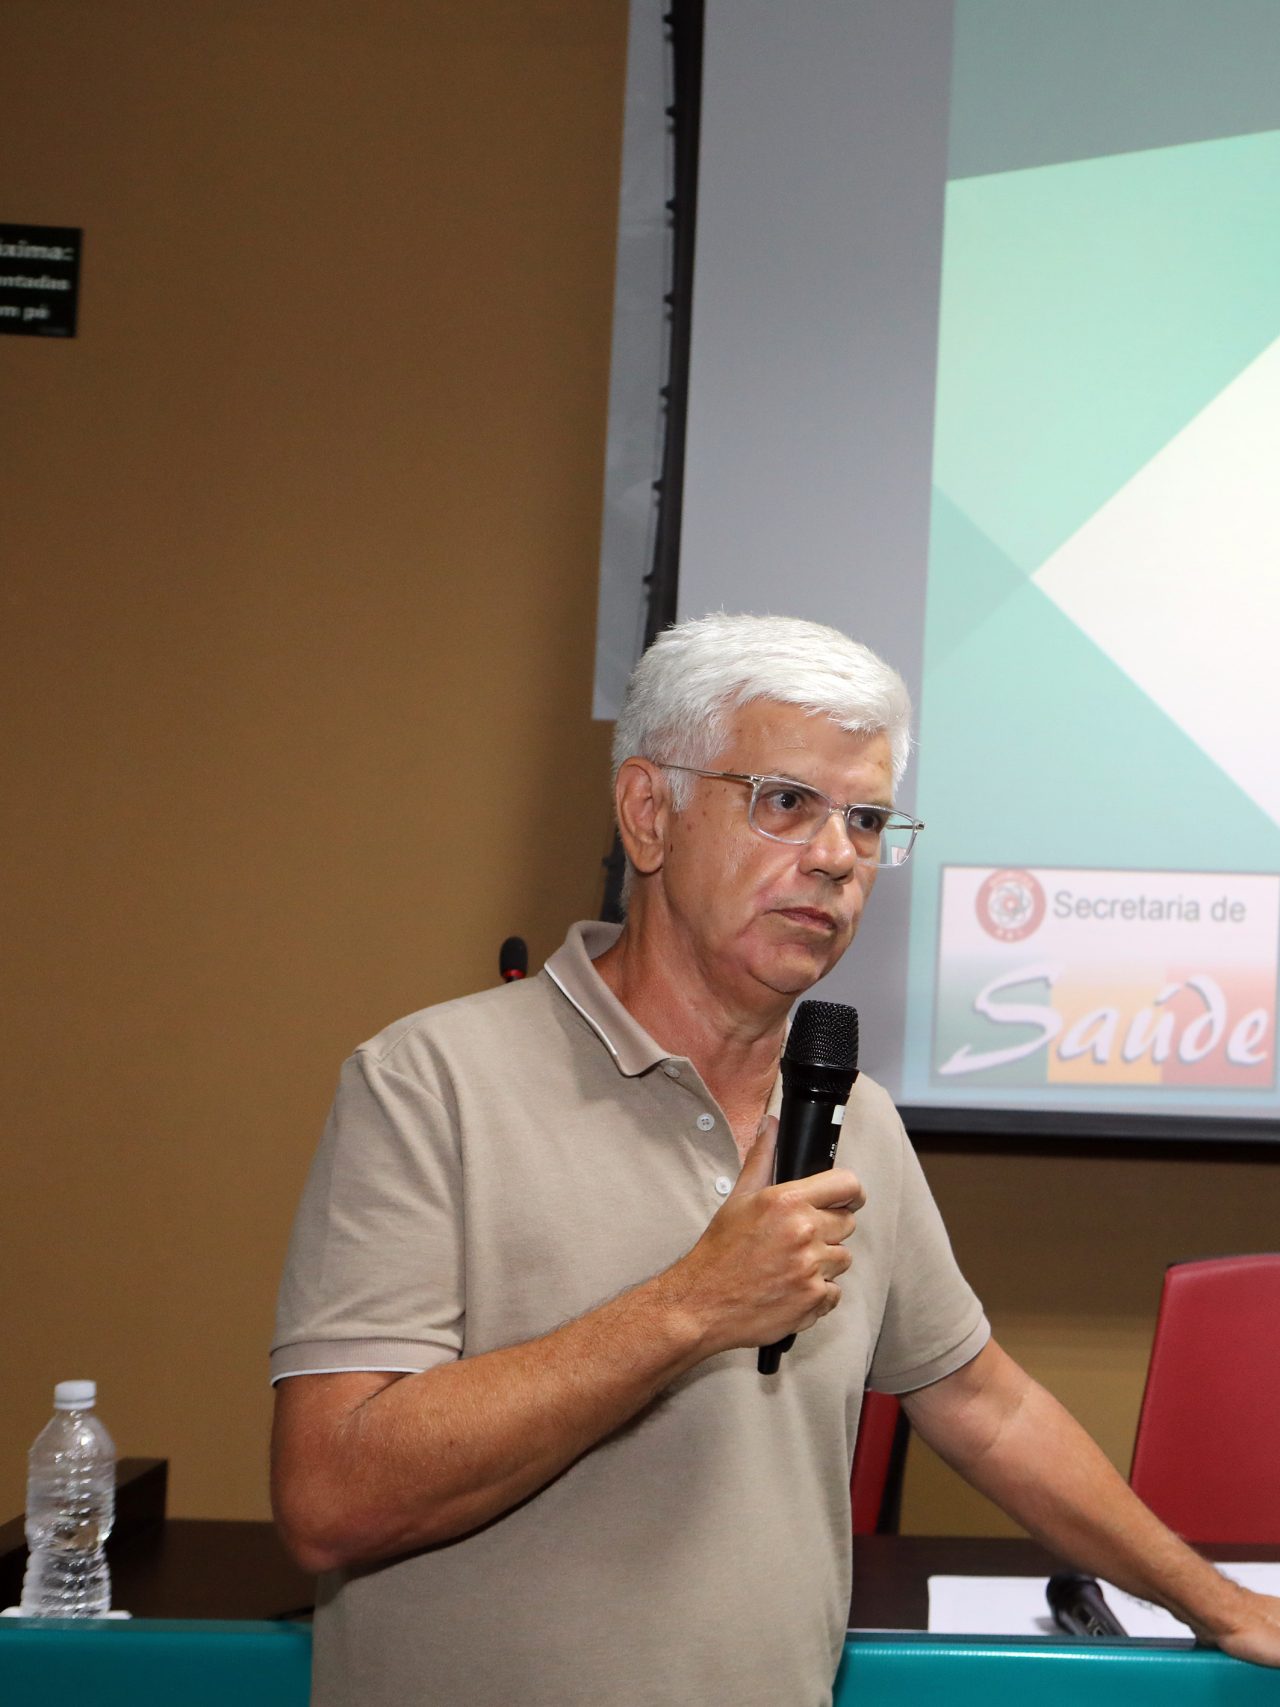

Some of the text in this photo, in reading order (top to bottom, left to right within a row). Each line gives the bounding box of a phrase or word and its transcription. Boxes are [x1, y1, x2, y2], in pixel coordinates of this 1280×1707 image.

[1053, 890, 1247, 923] Secretaria de
[939, 961, 1269, 1076] Saúde
